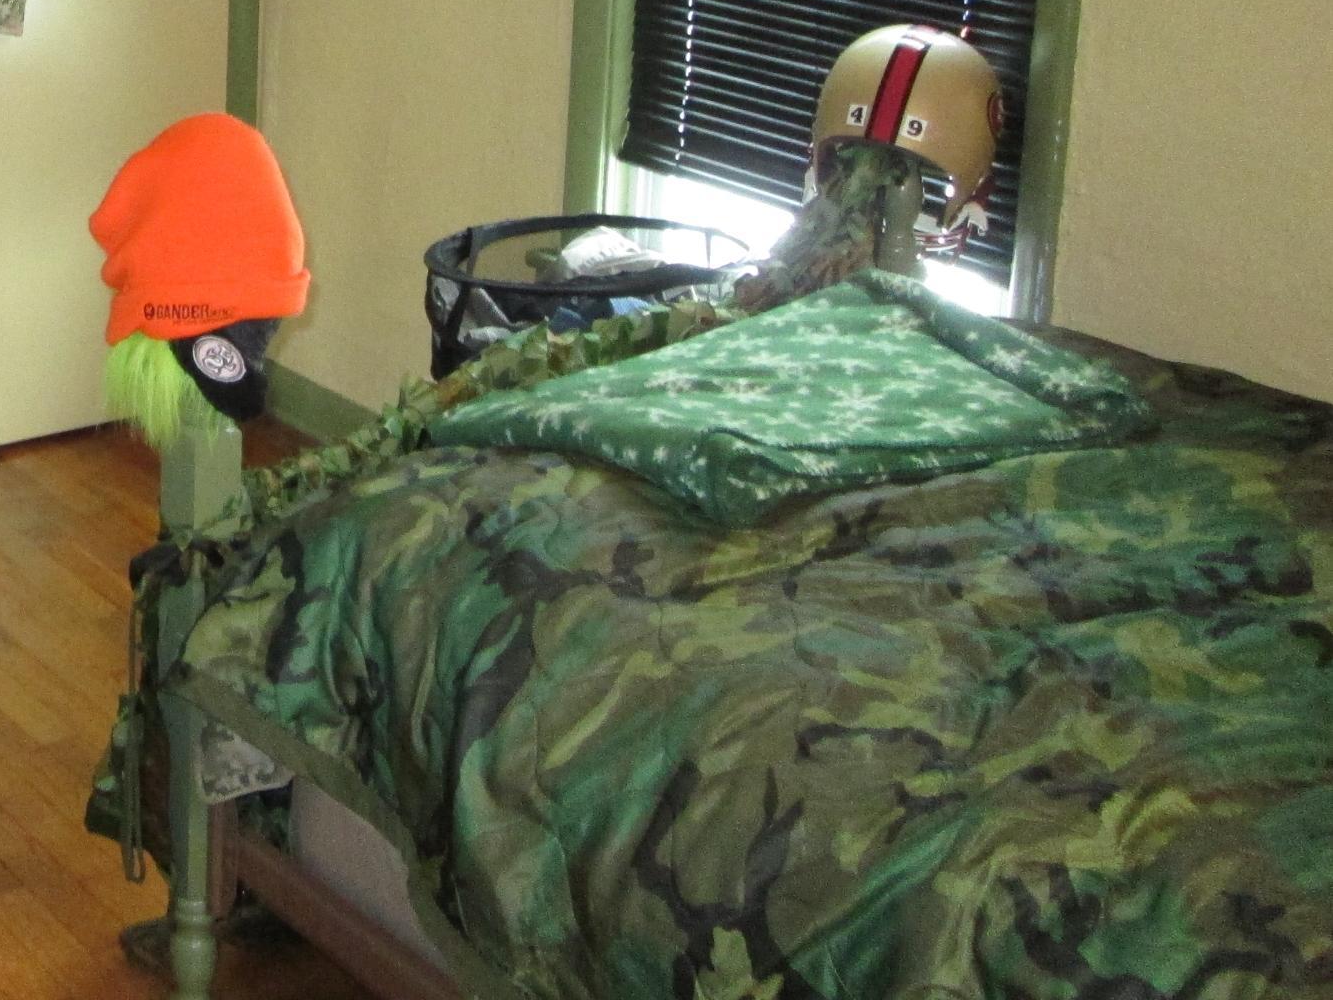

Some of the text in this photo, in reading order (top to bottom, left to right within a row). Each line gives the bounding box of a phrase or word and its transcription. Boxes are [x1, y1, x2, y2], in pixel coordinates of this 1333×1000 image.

[850, 107, 923, 137] 4 9
[155, 303, 210, 320] GANDER
